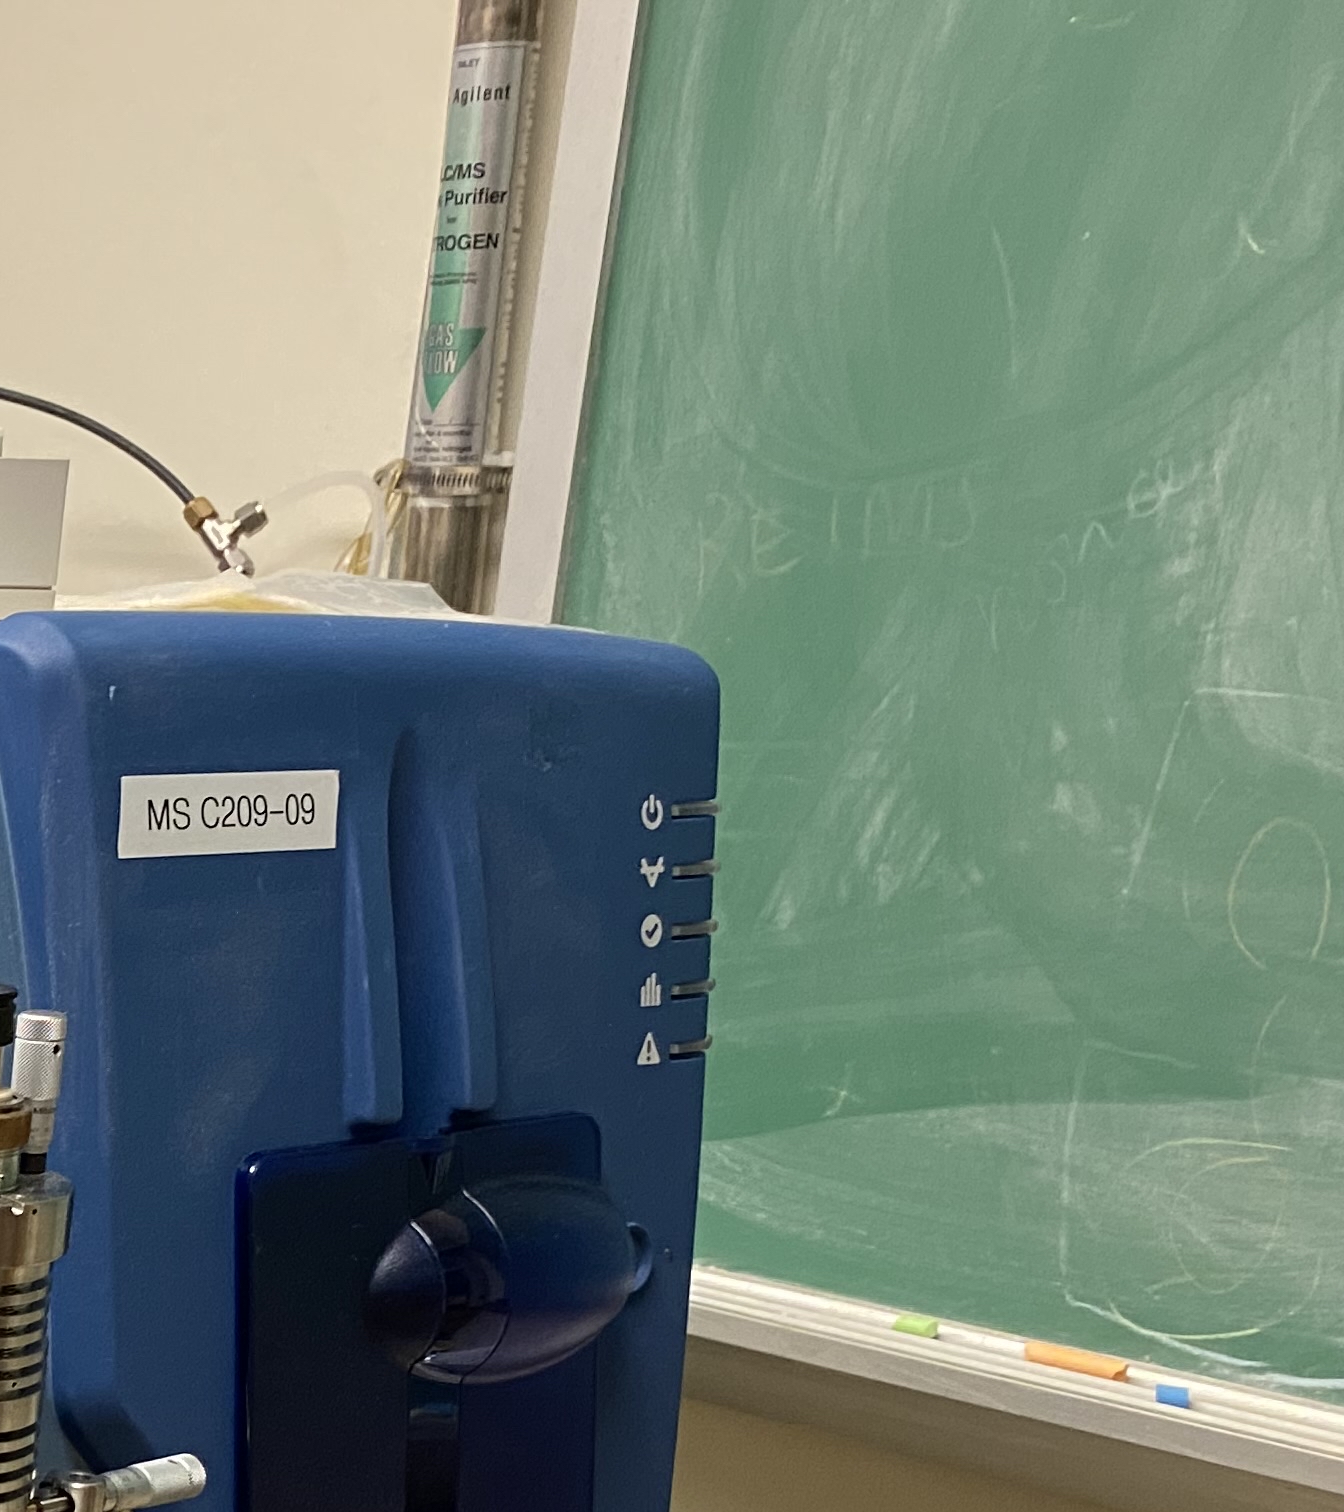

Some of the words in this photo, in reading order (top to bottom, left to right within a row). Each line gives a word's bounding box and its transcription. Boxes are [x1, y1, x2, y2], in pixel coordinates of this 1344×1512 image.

[453, 84, 511, 107] Agilent
[445, 187, 508, 206] Purifier
[148, 798, 190, 830] MS
[201, 793, 315, 829] C209-09
